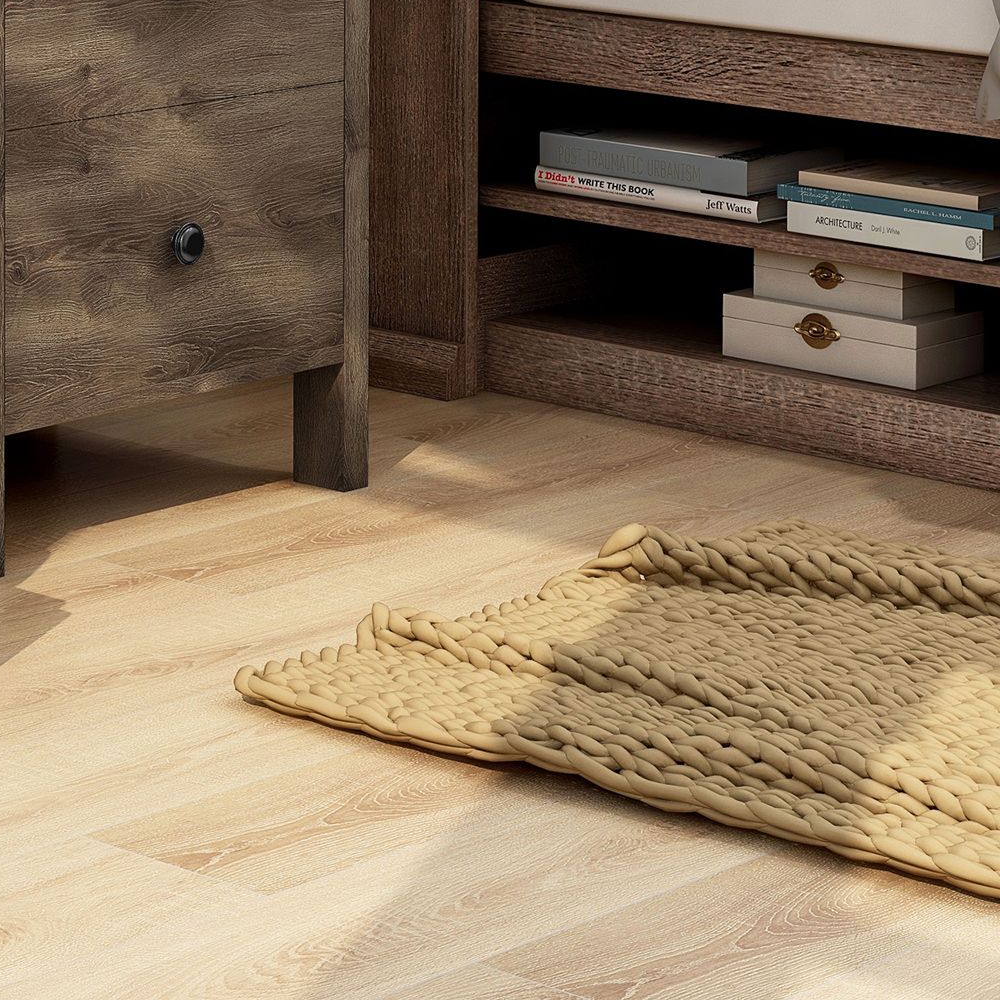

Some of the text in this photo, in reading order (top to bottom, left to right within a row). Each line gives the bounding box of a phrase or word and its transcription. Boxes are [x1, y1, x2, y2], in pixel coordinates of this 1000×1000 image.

[647, 159, 702, 183] URBANISM
[537, 170, 543, 179] I
[544, 171, 576, 184] Didn't
[578, 177, 605, 189] WRITE
[606, 181, 627, 192] THIS
[628, 185, 655, 197] BOOK
[705, 199, 752, 215] Jeff Watts
[903, 207, 931, 216] RACHEL
[938, 212, 962, 221] HAMM
[815, 216, 863, 231] ARCHITECTURE
